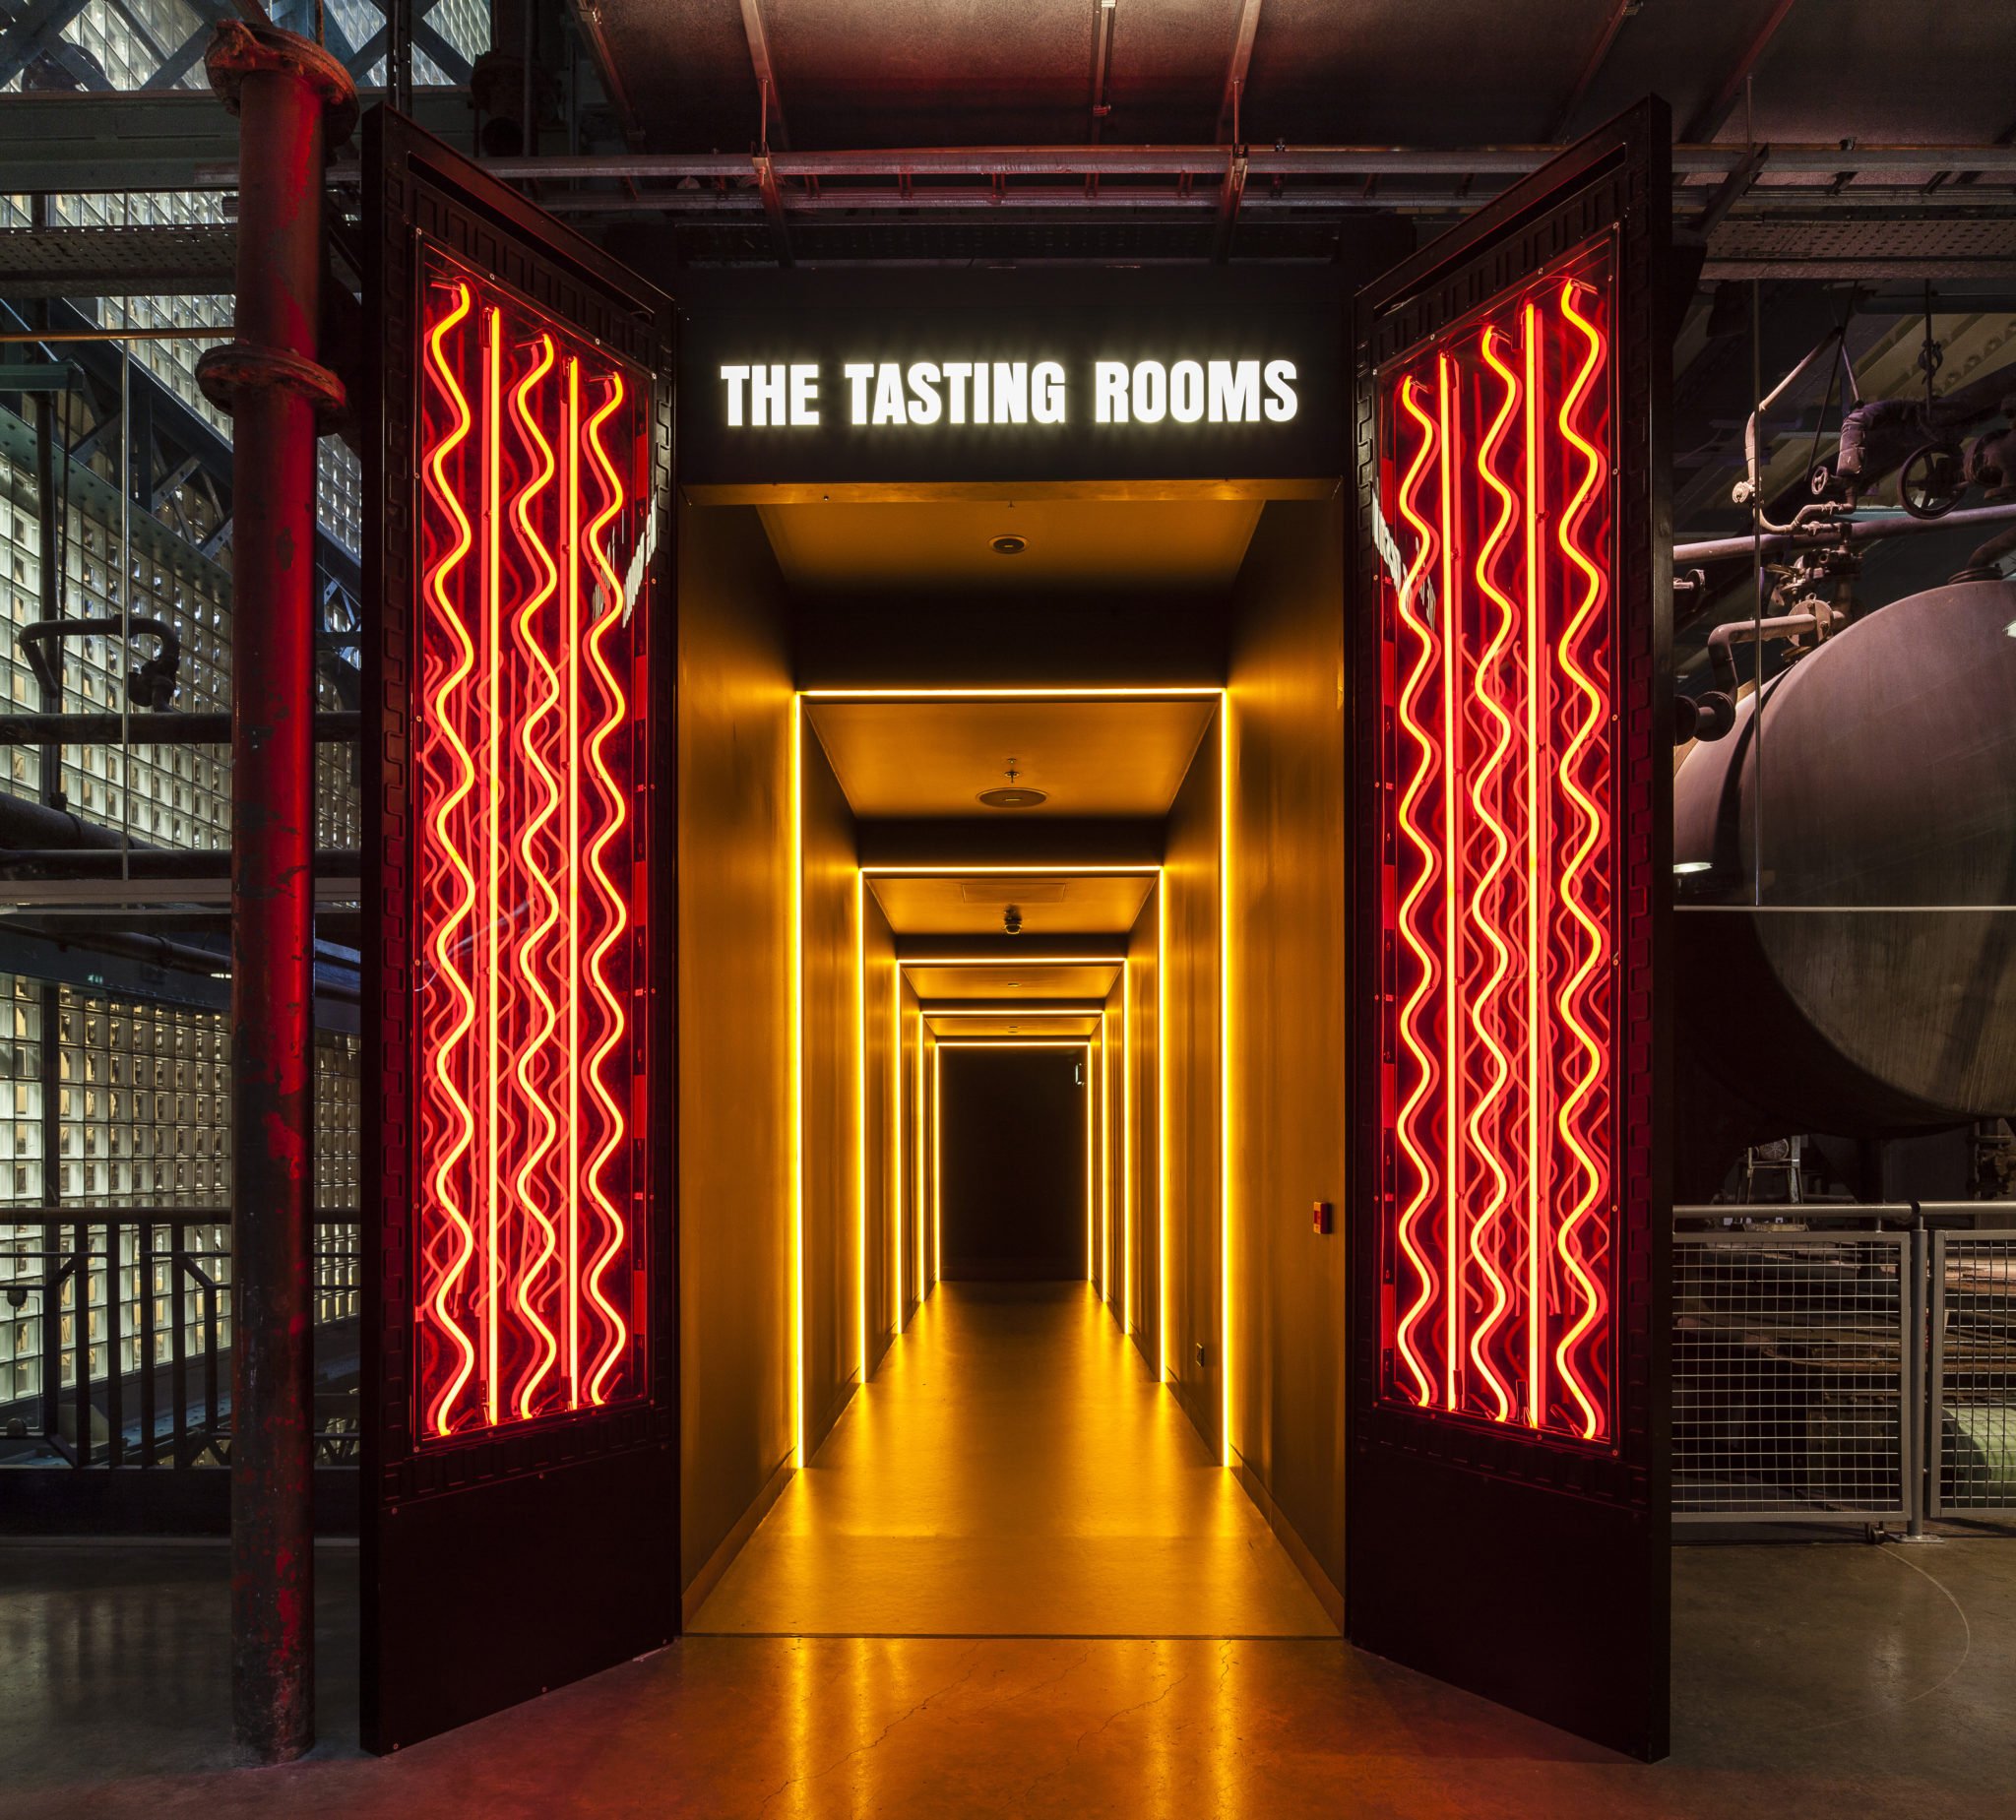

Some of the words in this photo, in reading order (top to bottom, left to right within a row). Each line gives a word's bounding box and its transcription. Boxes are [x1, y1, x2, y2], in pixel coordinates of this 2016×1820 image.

[721, 364, 819, 426] THE
[845, 361, 1065, 425] TASTING
[1095, 360, 1297, 423] ROOMS
